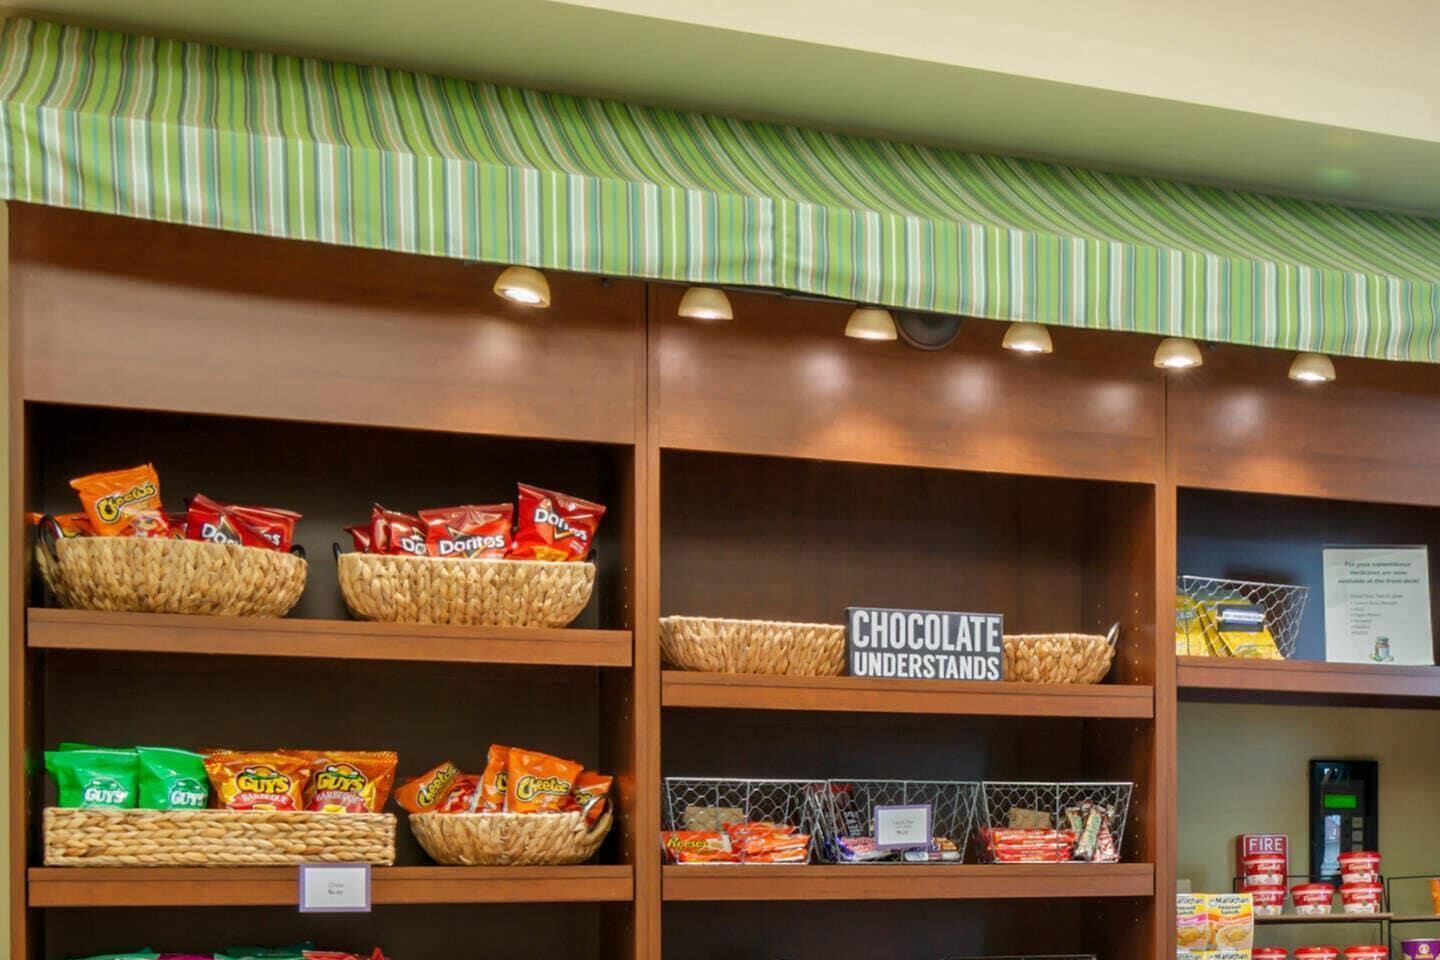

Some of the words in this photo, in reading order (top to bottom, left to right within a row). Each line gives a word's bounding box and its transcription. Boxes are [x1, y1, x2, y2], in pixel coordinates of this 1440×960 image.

[439, 534, 505, 555] Doritos
[852, 609, 1001, 653] CHOCOLATE
[854, 651, 1000, 681] UNDERSTANDS
[1249, 837, 1283, 851] FIRE
